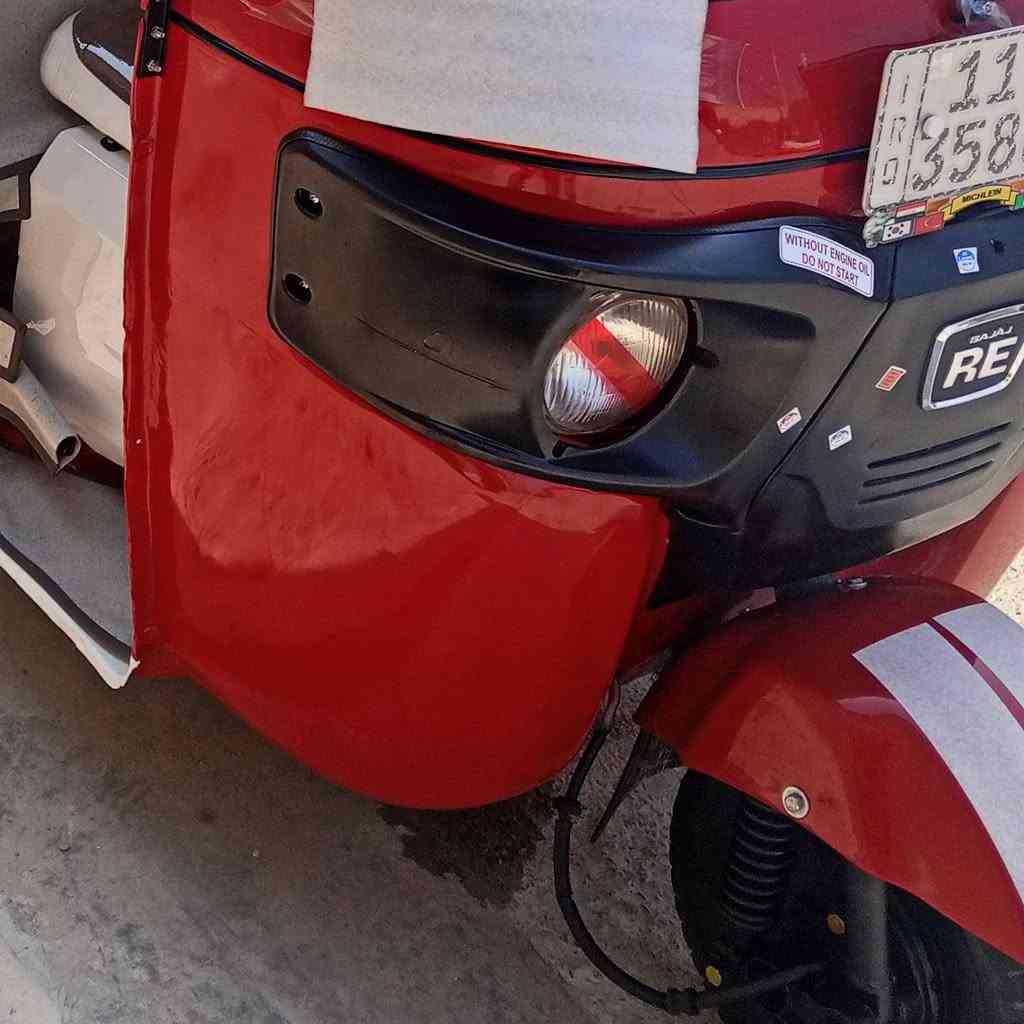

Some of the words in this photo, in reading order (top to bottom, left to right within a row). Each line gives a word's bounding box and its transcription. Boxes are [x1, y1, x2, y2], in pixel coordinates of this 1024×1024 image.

[912, 112, 1024, 191] 358
[784, 232, 829, 256] WITHOUT
[830, 246, 857, 270] ENGINE
[858, 261, 870, 277] OIL
[801, 252, 816, 267] DO
[817, 258, 835, 275] NOT
[836, 266, 859, 287] START
[942, 336, 1019, 389] RE
